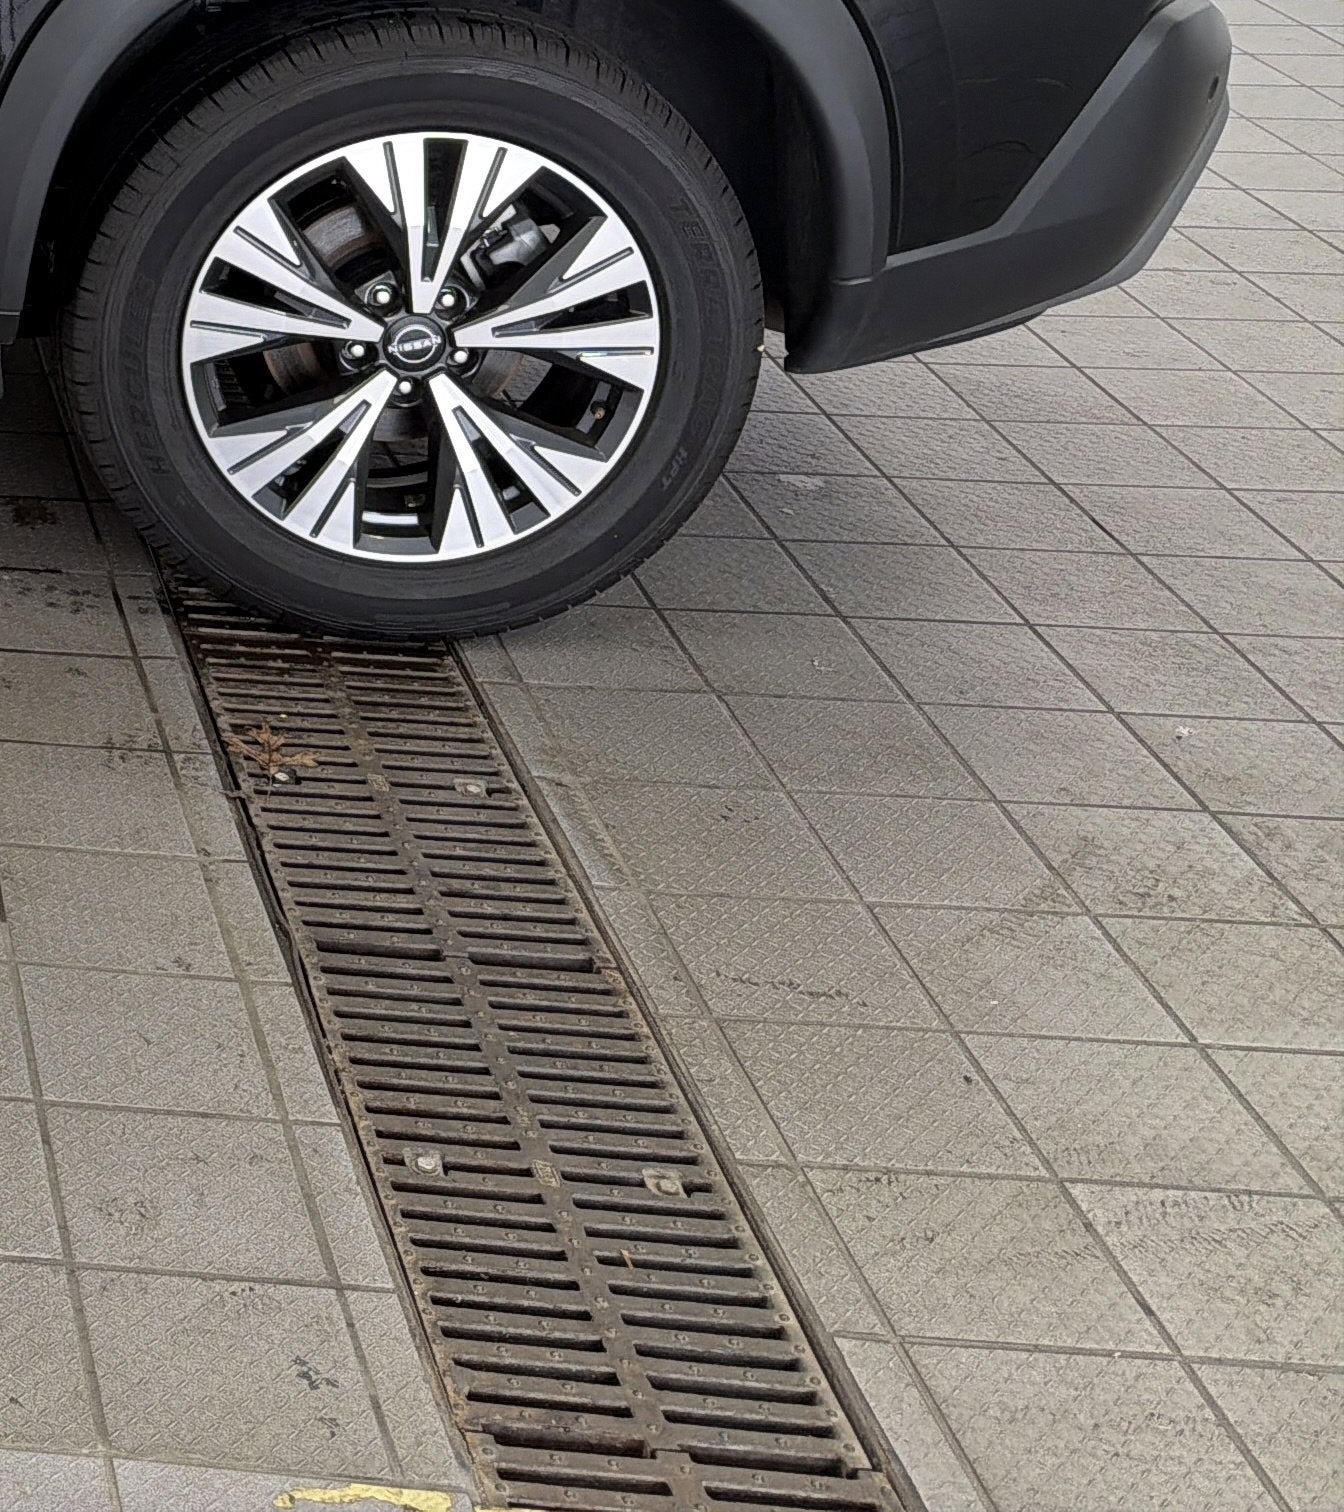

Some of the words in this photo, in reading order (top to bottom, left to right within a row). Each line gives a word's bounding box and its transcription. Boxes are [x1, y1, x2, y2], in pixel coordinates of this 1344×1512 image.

[387, 334, 442, 354] NISSAN
[120, 273, 172, 476] HERCULES
[661, 445, 689, 490] HPT
